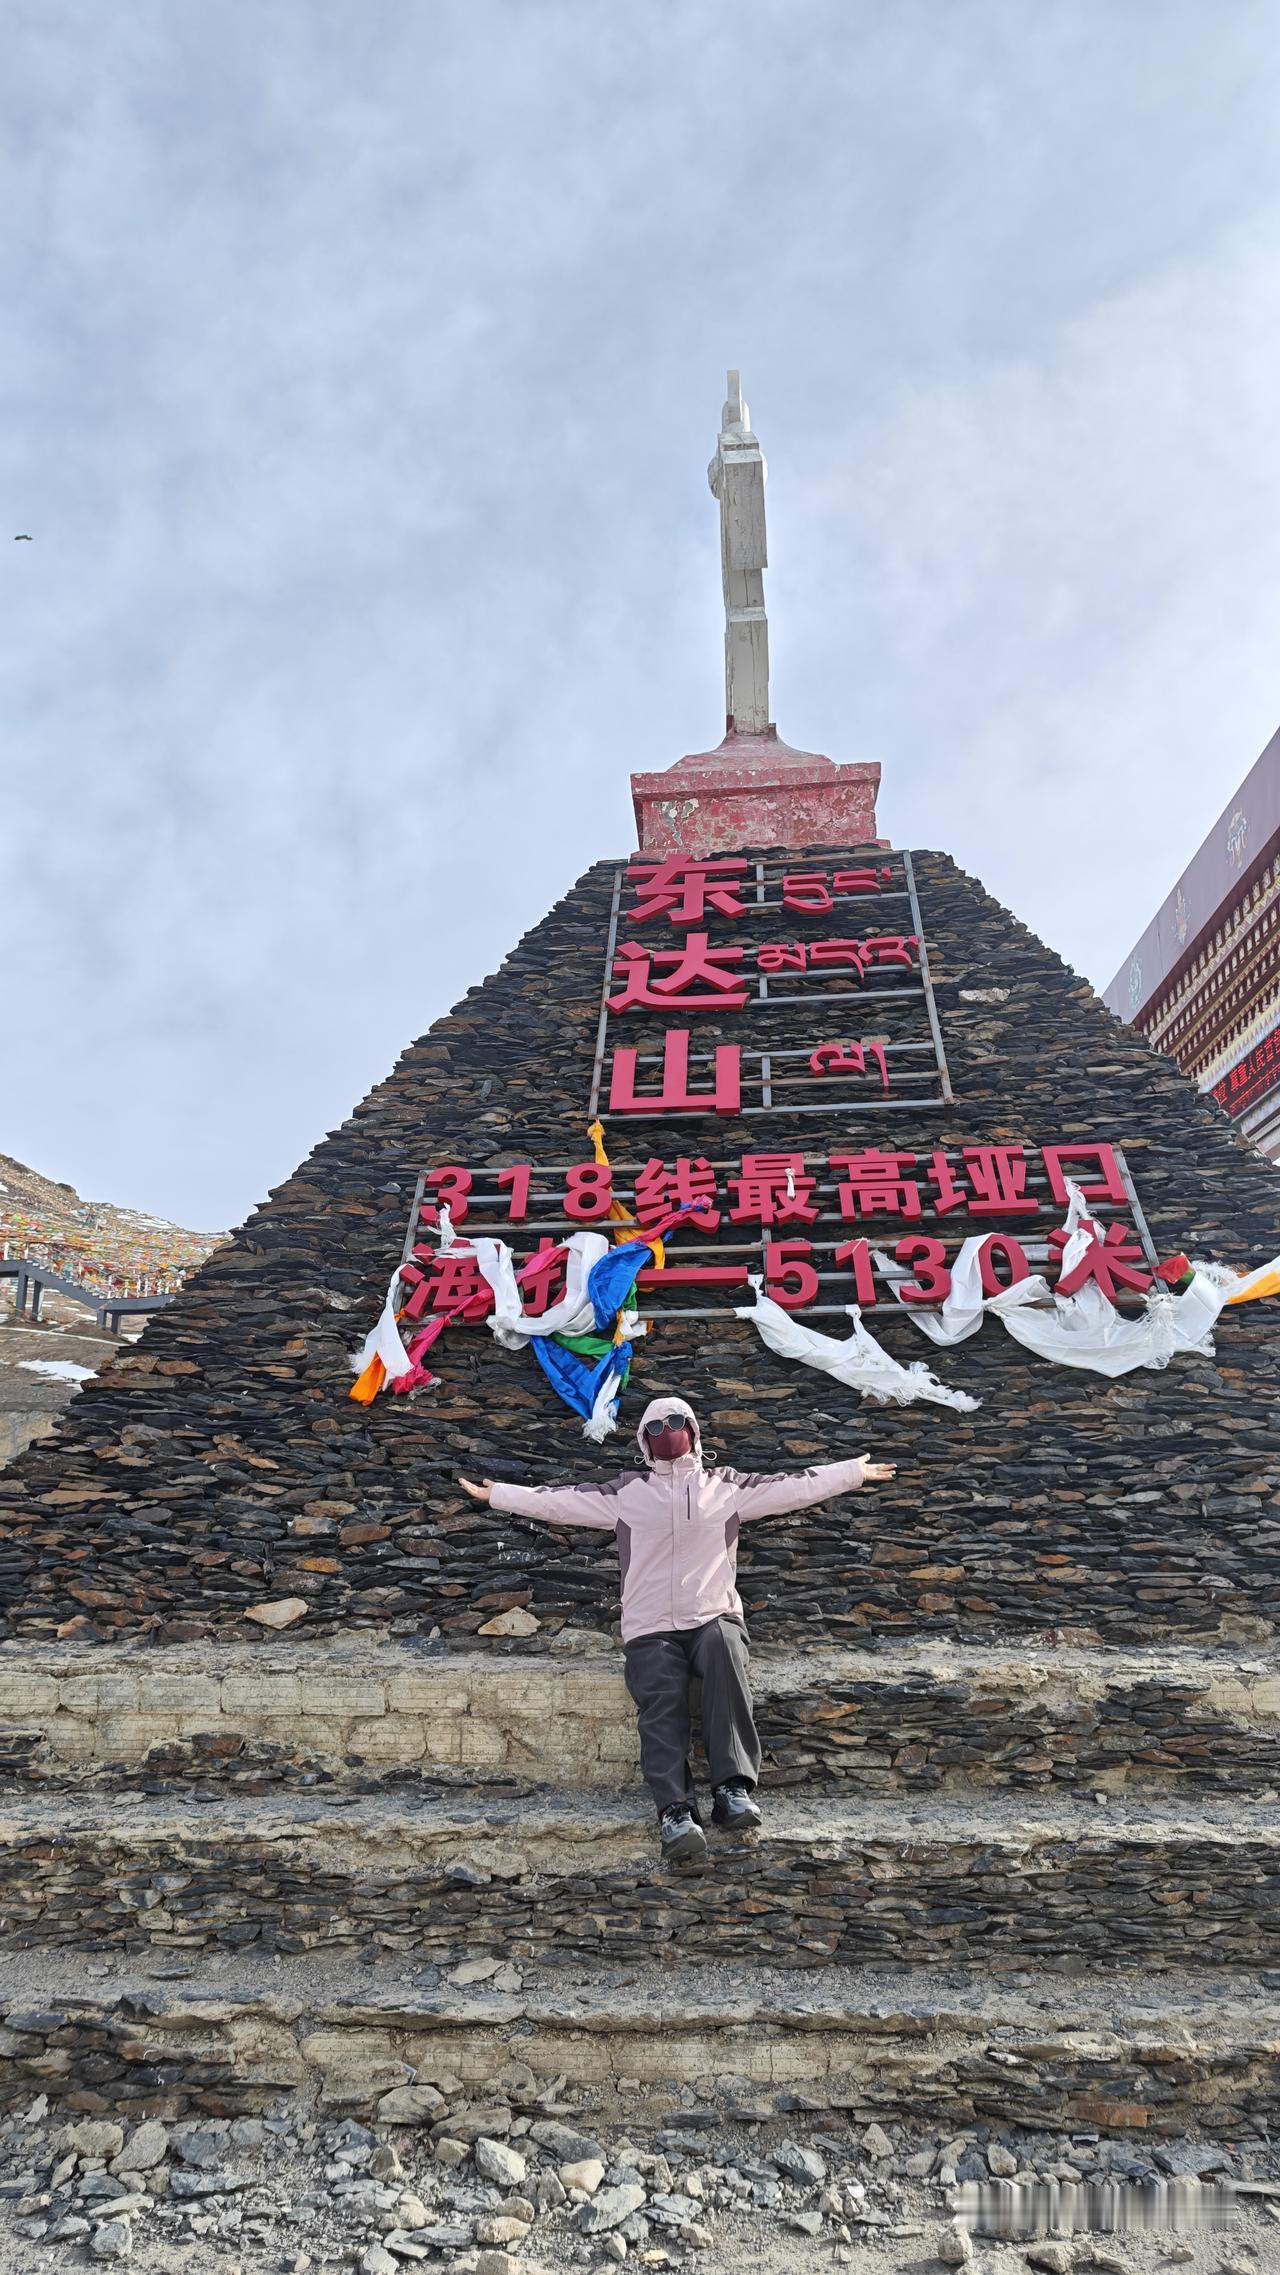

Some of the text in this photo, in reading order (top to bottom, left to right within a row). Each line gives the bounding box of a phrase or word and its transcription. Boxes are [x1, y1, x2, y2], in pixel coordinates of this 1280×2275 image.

[419, 1143, 1129, 1236] 318线最高垭口
